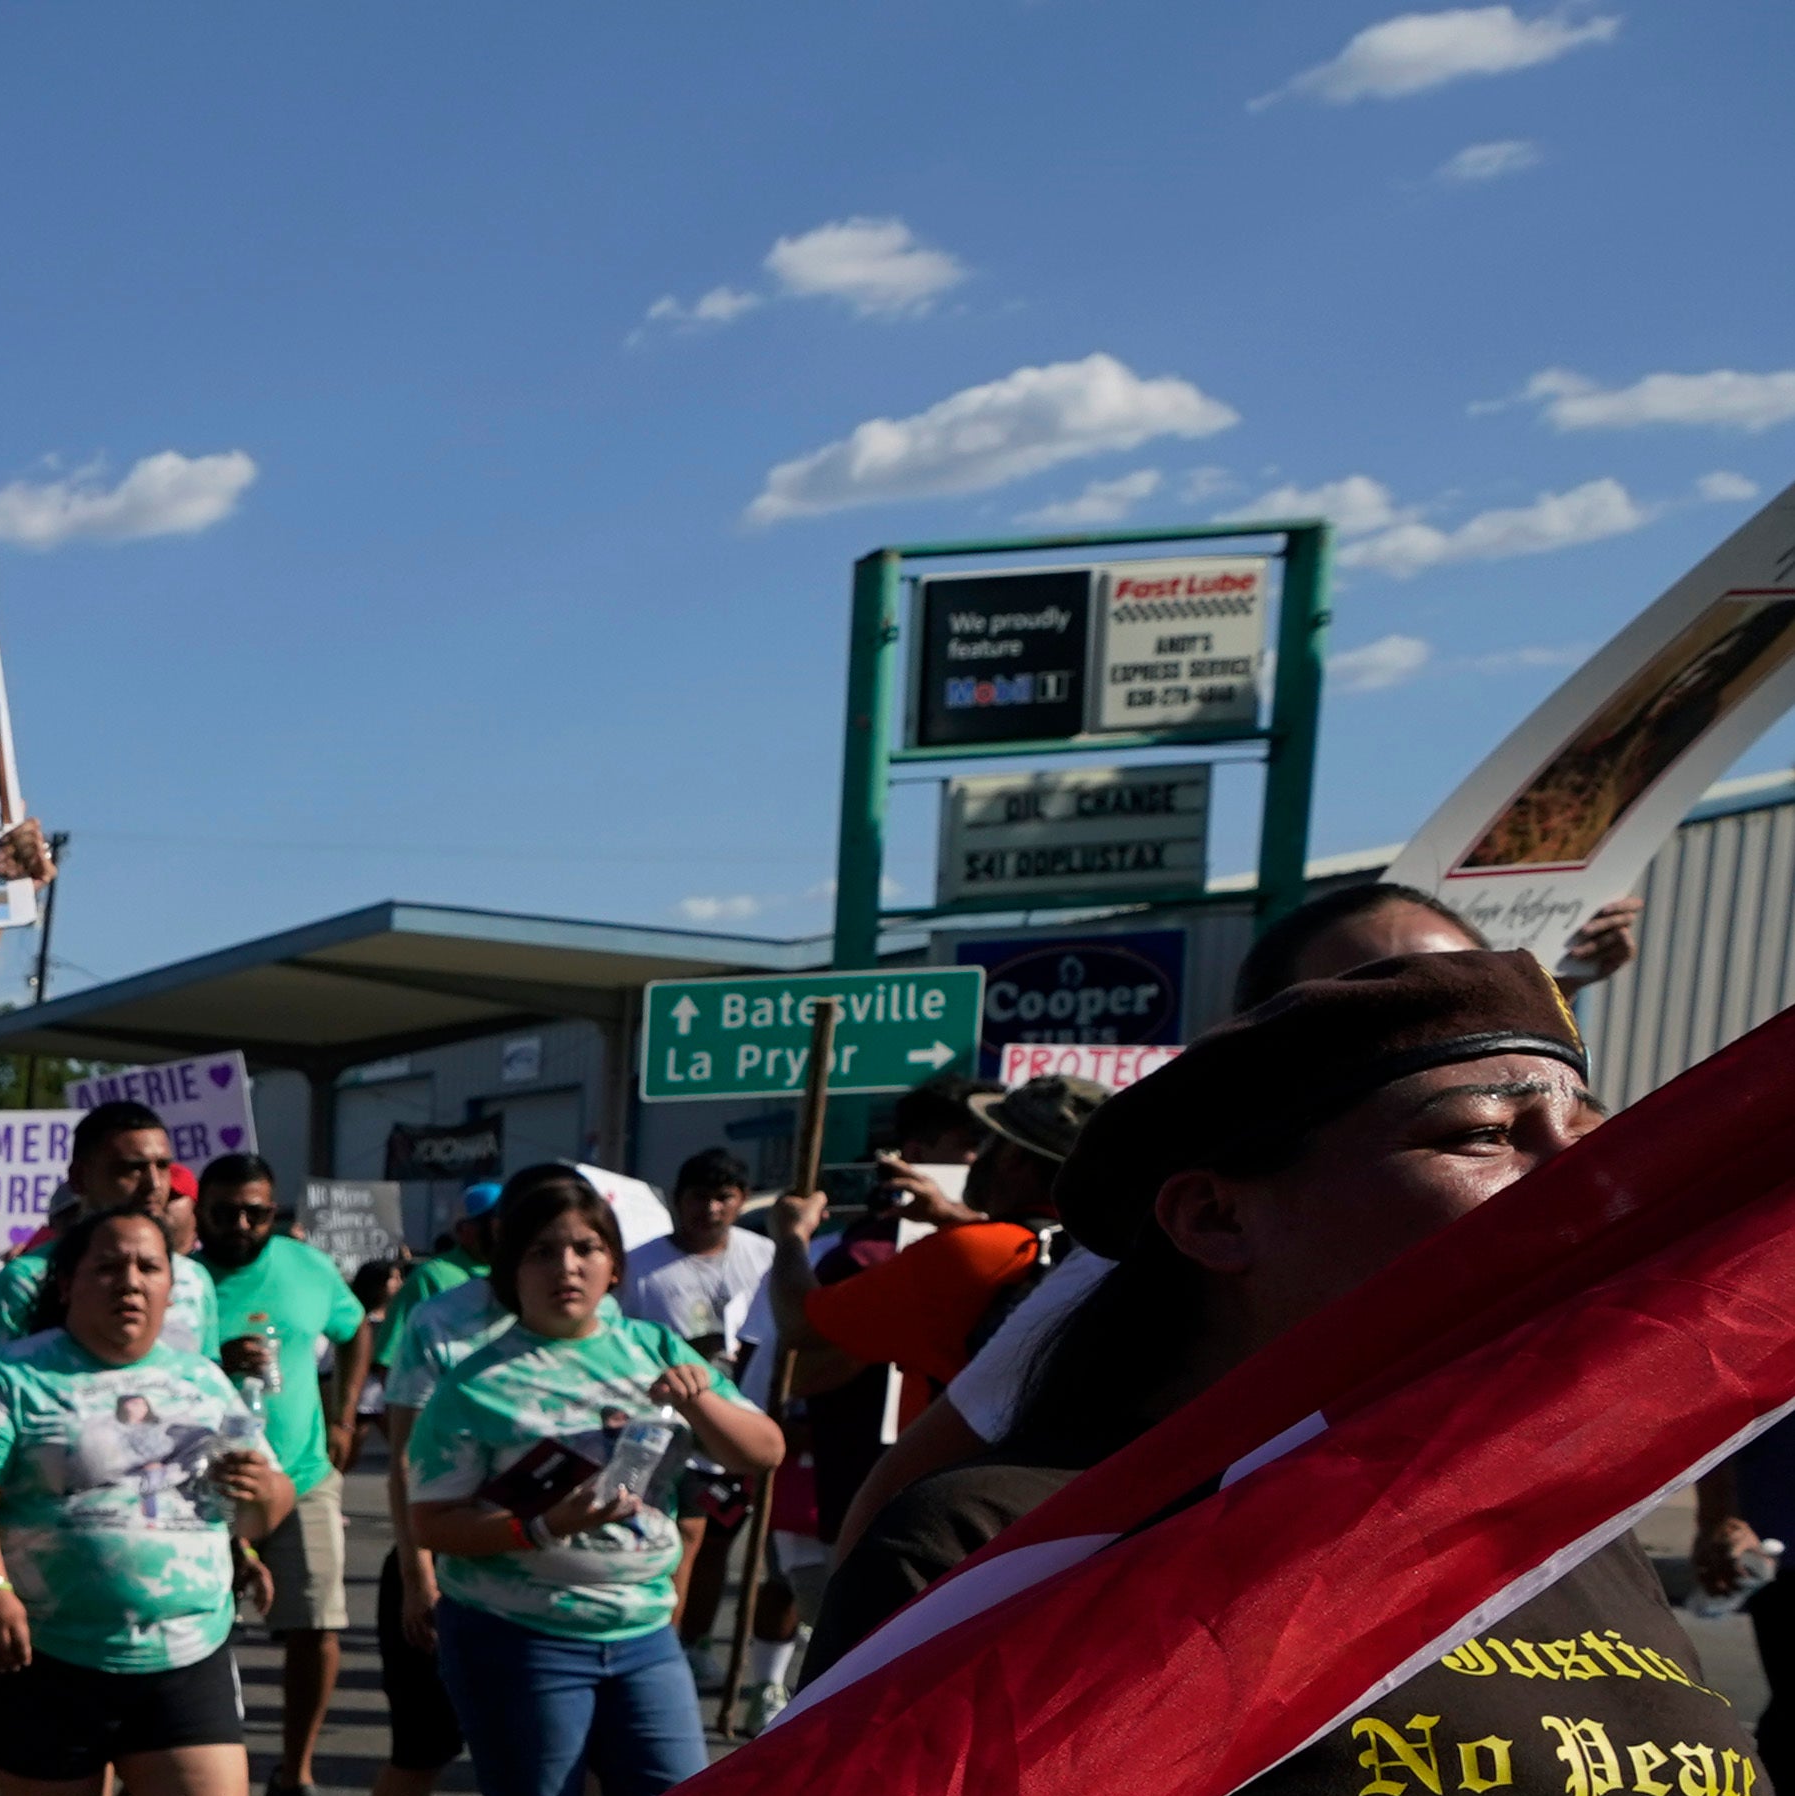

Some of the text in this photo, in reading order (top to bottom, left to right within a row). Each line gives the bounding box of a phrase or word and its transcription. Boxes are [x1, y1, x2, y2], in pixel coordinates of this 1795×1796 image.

[1115, 572, 1256, 600] Fast Lube
[948, 605, 1072, 637] We proudly
[947, 638, 1024, 660] feature
[946, 673, 1035, 709] Mobil
[720, 982, 948, 1030] Batesville
[983, 979, 1161, 1027] Cooper
[665, 1046, 713, 1083] La
